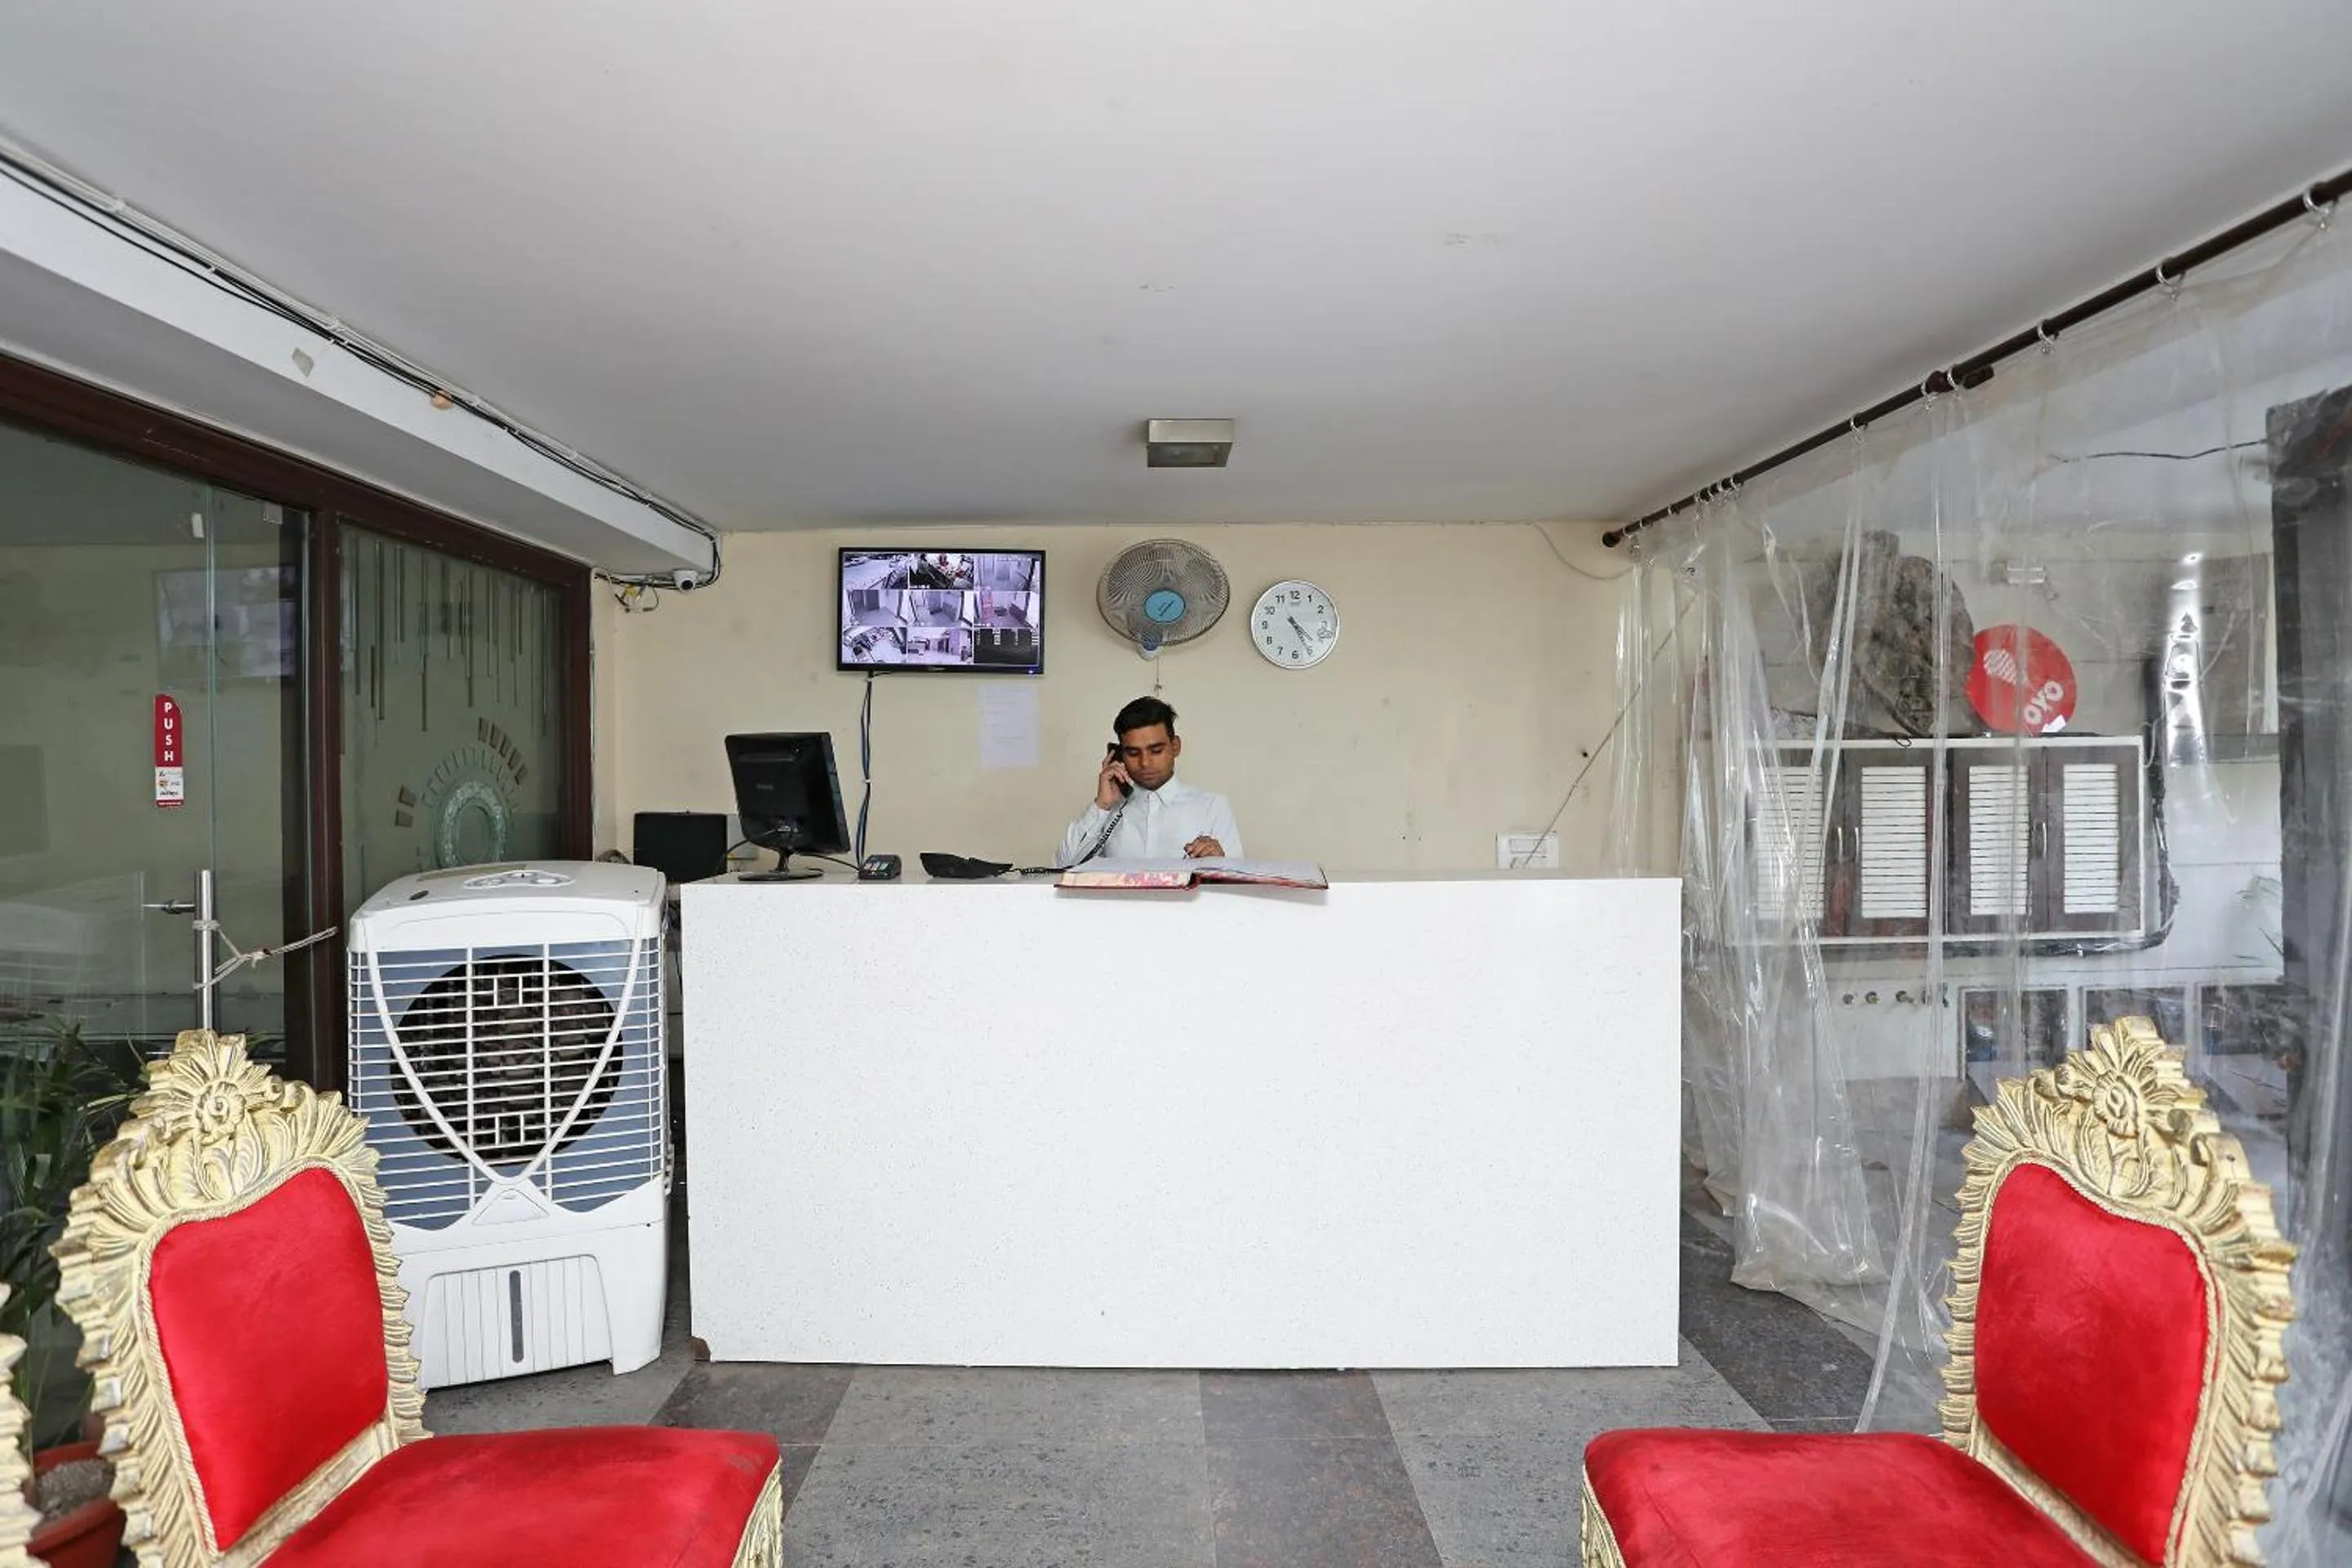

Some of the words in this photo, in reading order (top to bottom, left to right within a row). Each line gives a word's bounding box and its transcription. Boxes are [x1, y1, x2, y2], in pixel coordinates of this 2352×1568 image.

[1290, 590, 1300, 599] 12
[1307, 594, 1312, 603] 1
[1265, 605, 1275, 615] 10
[1317, 604, 1324, 614] 2
[1262, 621, 1267, 630] 9
[1267, 636, 1272, 644] 8
[1276, 646, 1283, 655] 7
[1291, 650, 1298, 659] 6
[2023, 680, 2064, 725] OYO
[164, 702, 173, 761] PUSH
